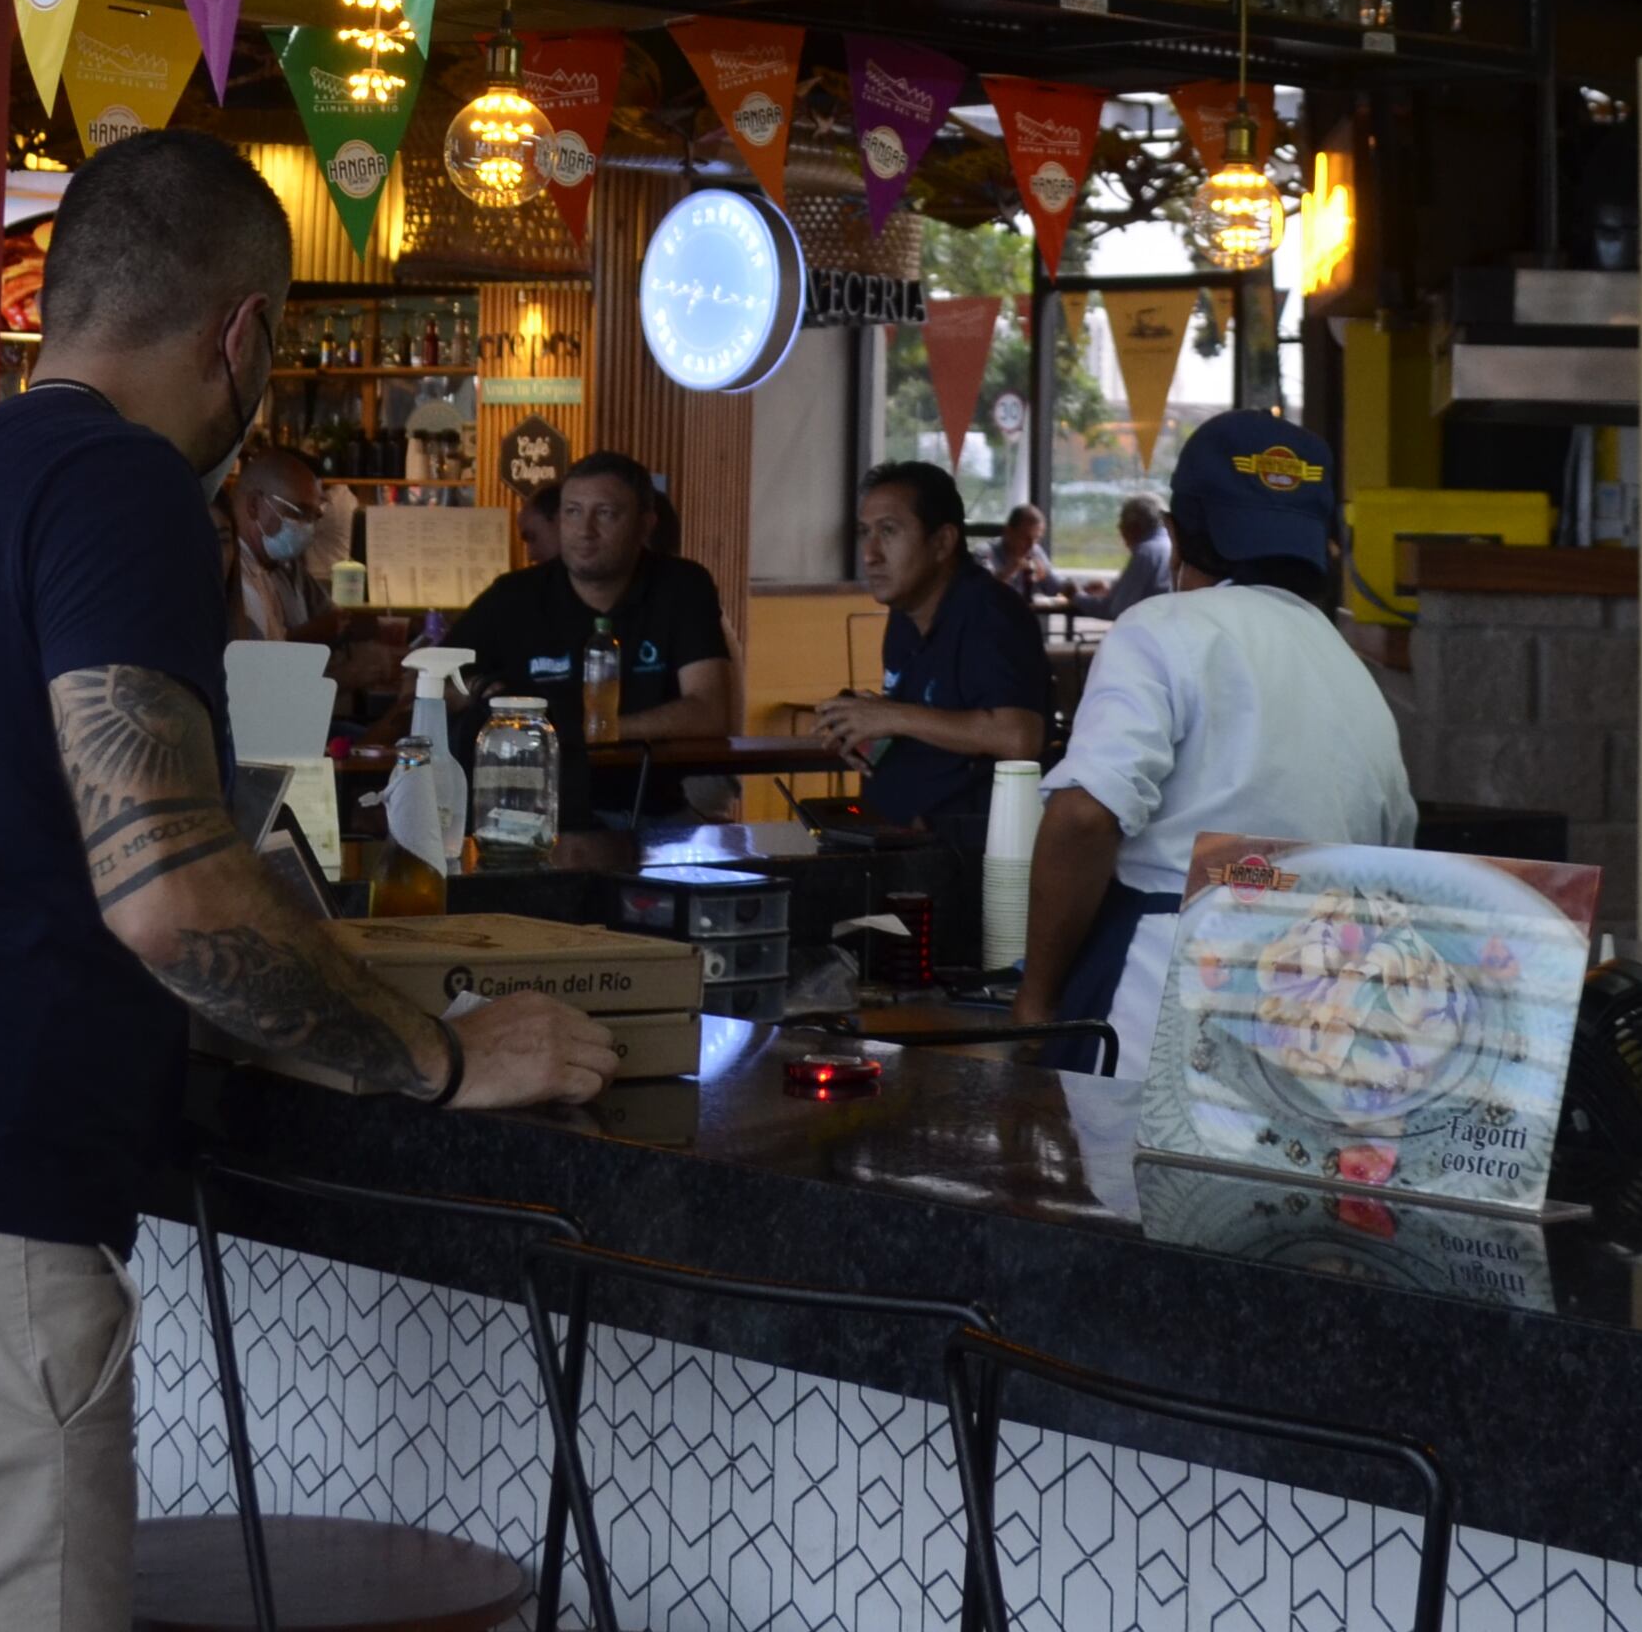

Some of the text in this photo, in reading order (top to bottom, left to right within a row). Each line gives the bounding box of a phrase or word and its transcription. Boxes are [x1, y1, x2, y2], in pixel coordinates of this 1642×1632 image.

[999, 399, 1020, 421] 30
[479, 971, 632, 997] Caimán del Río
[1449, 1115, 1527, 1151] Fagotti
